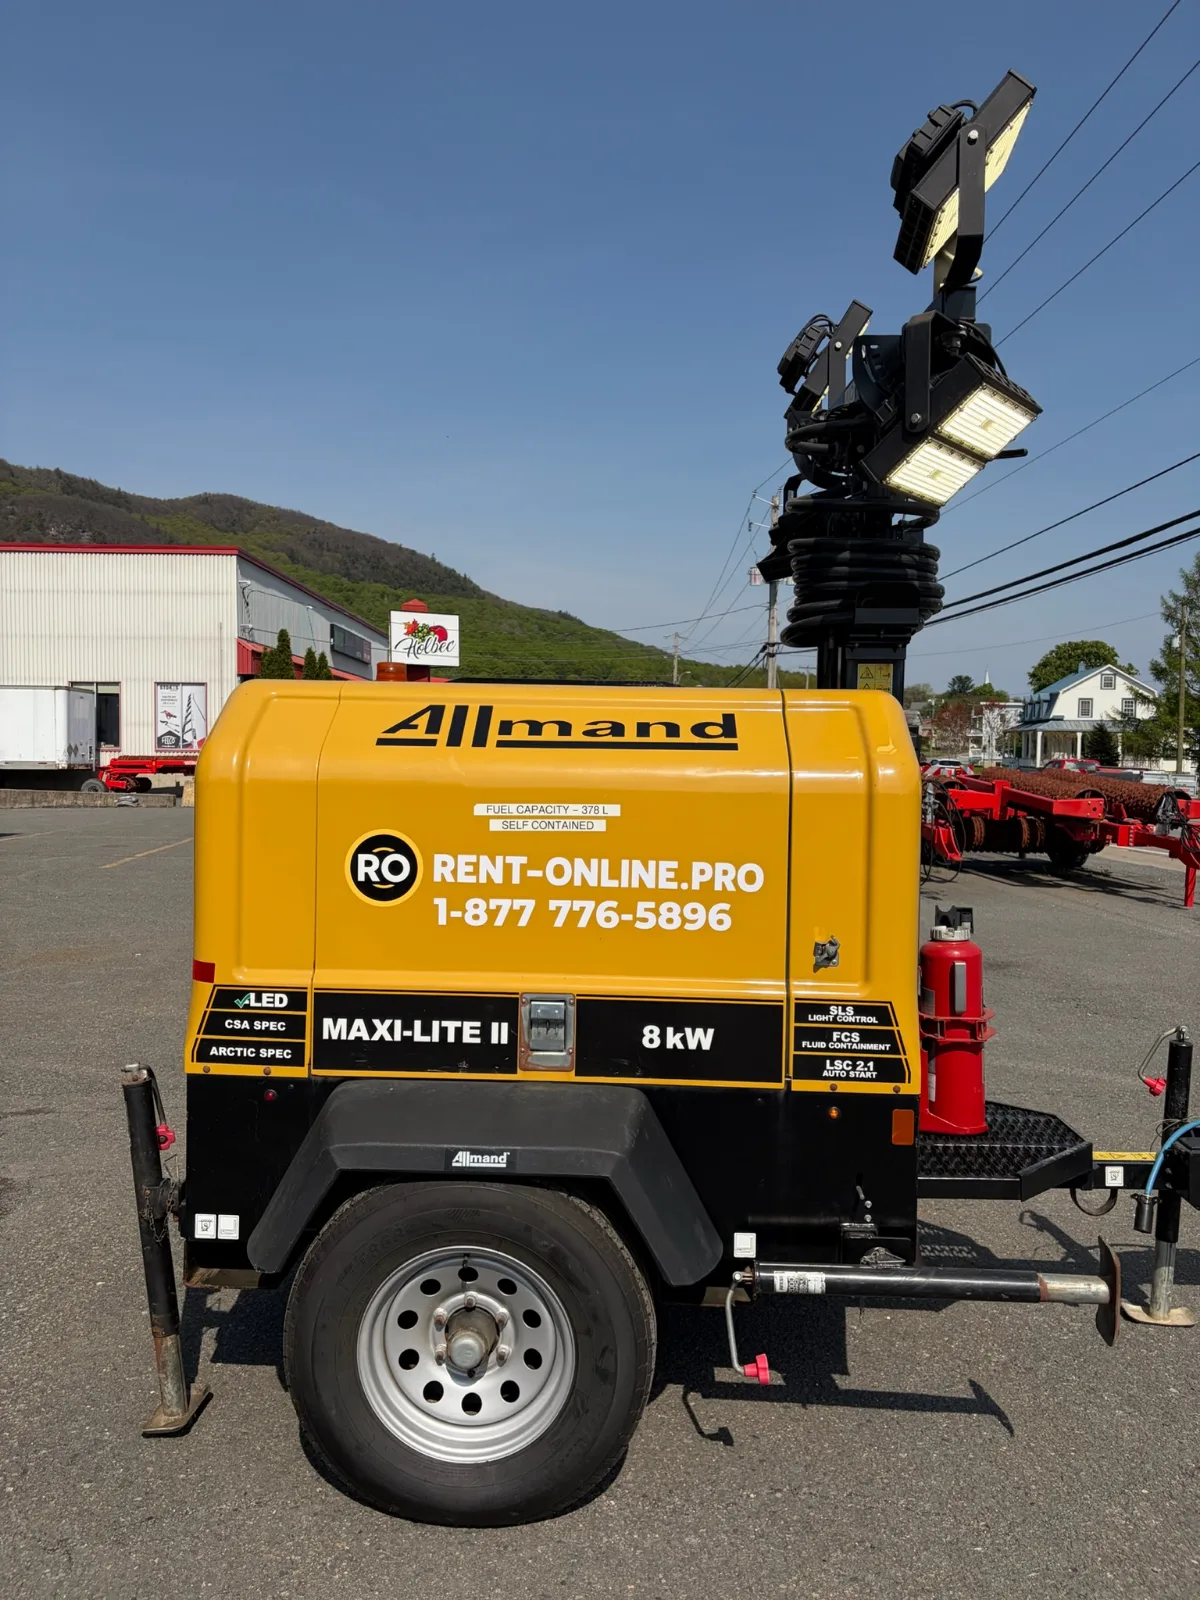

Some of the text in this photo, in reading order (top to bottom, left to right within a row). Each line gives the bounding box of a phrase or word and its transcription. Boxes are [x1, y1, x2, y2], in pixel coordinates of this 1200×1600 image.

[394, 636, 456, 659] Holbec
[376, 704, 739, 751] Allmand
[486, 805, 513, 815] FUEL
[516, 805, 570, 815] CAPACITY
[581, 805, 600, 815] 378
[602, 806, 608, 815] L
[501, 820, 594, 831] SELF CONTAINED
[357, 853, 411, 883] RO
[433, 853, 765, 893] RENT-ONLINE.PRO
[433, 897, 732, 932] 1-877 776-5896
[829, 1005, 854, 1016] SLS
[225, 1019, 286, 1031] CSA SPEC
[808, 1014, 879, 1024] LIGHT CONTROL
[322, 1017, 509, 1045] MAXI-LITE II
[832, 1031, 860, 1043] FCS
[641, 1025, 715, 1050] 8 kW
[802, 1041, 891, 1051] FLUID CONTAINMENT
[210, 1046, 292, 1059] ARCTIC SPEC
[825, 1059, 874, 1071] LSC 2.1
[822, 1070, 878, 1079] AUTO START
[452, 1151, 507, 1168] Allmand
